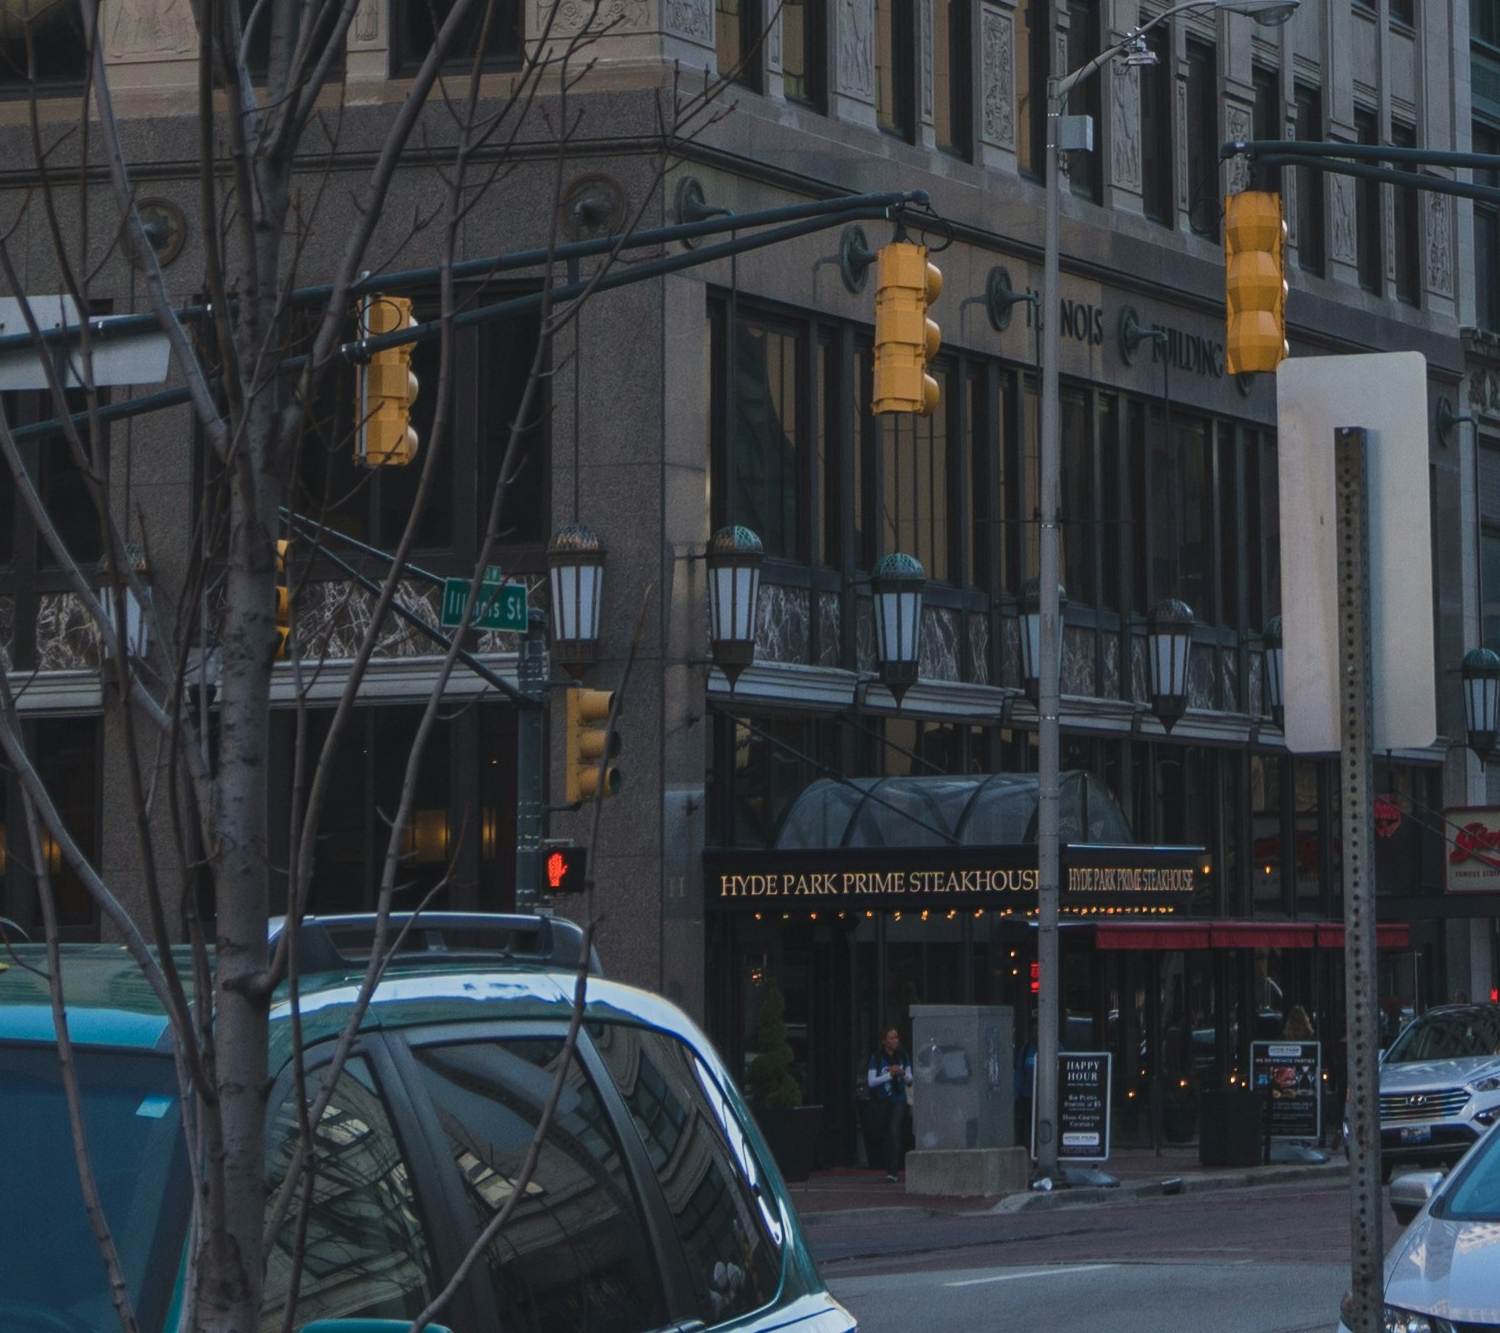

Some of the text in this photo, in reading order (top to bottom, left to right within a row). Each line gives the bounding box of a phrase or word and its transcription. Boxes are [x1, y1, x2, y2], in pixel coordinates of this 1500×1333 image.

[1026, 287, 1104, 346] ILNOIS
[449, 590, 523, 621] Illnois St
[719, 874, 777, 897] HYDE
[783, 872, 836, 896] PARK
[842, 871, 905, 894] PRIME
[1068, 868, 1194, 891] HYDE PARK PRIME STEAKHOUSE
[1066, 1060, 1100, 1071] HAPPY
[1068, 1072, 1098, 1082] HOUR
